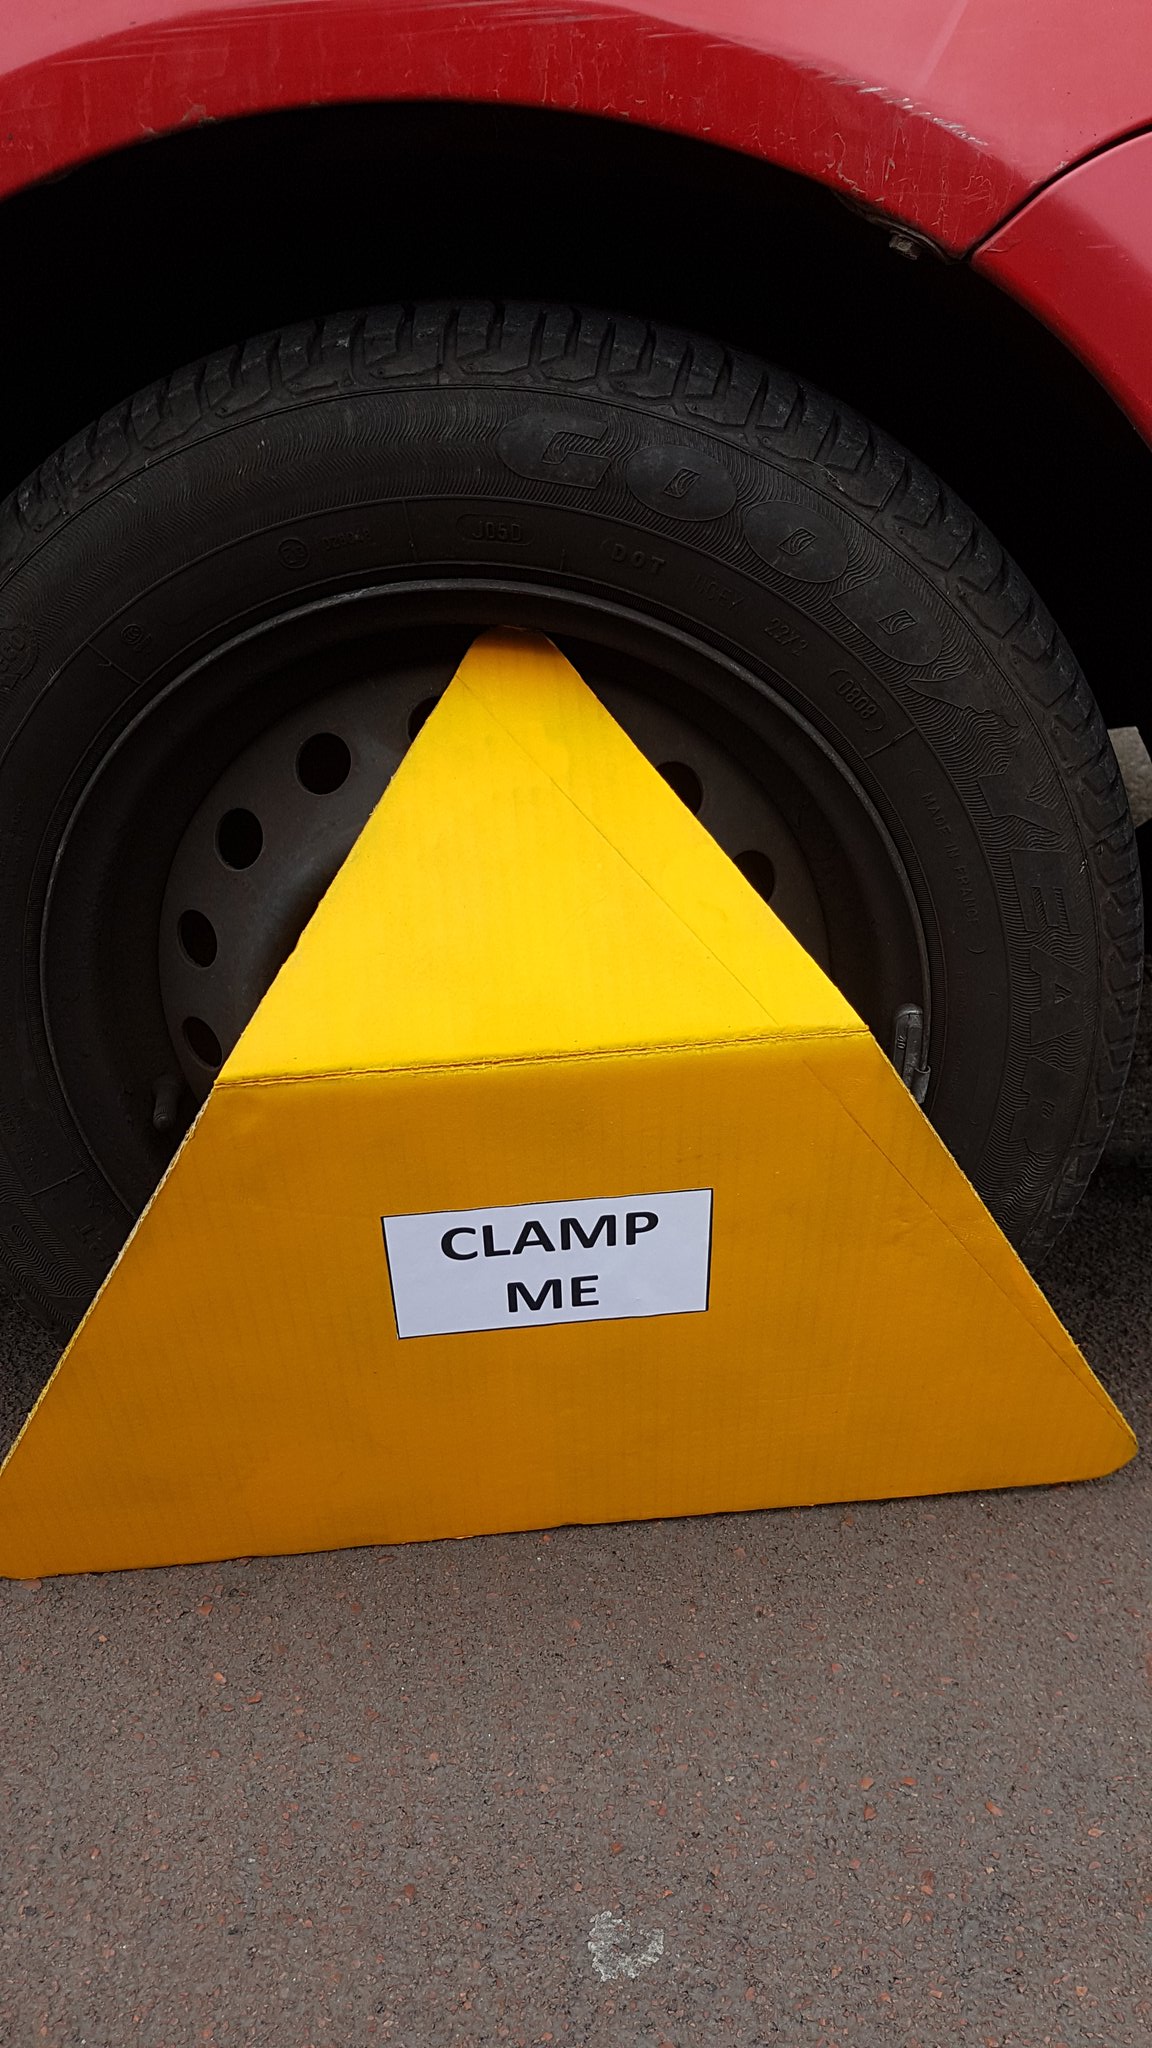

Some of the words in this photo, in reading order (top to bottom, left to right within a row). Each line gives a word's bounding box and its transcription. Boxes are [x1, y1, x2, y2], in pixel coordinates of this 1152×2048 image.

[609, 543, 666, 575] DOT
[920, 791, 952, 836] MADE
[440, 1211, 659, 1261] CLAMP
[507, 1275, 600, 1313] ME
